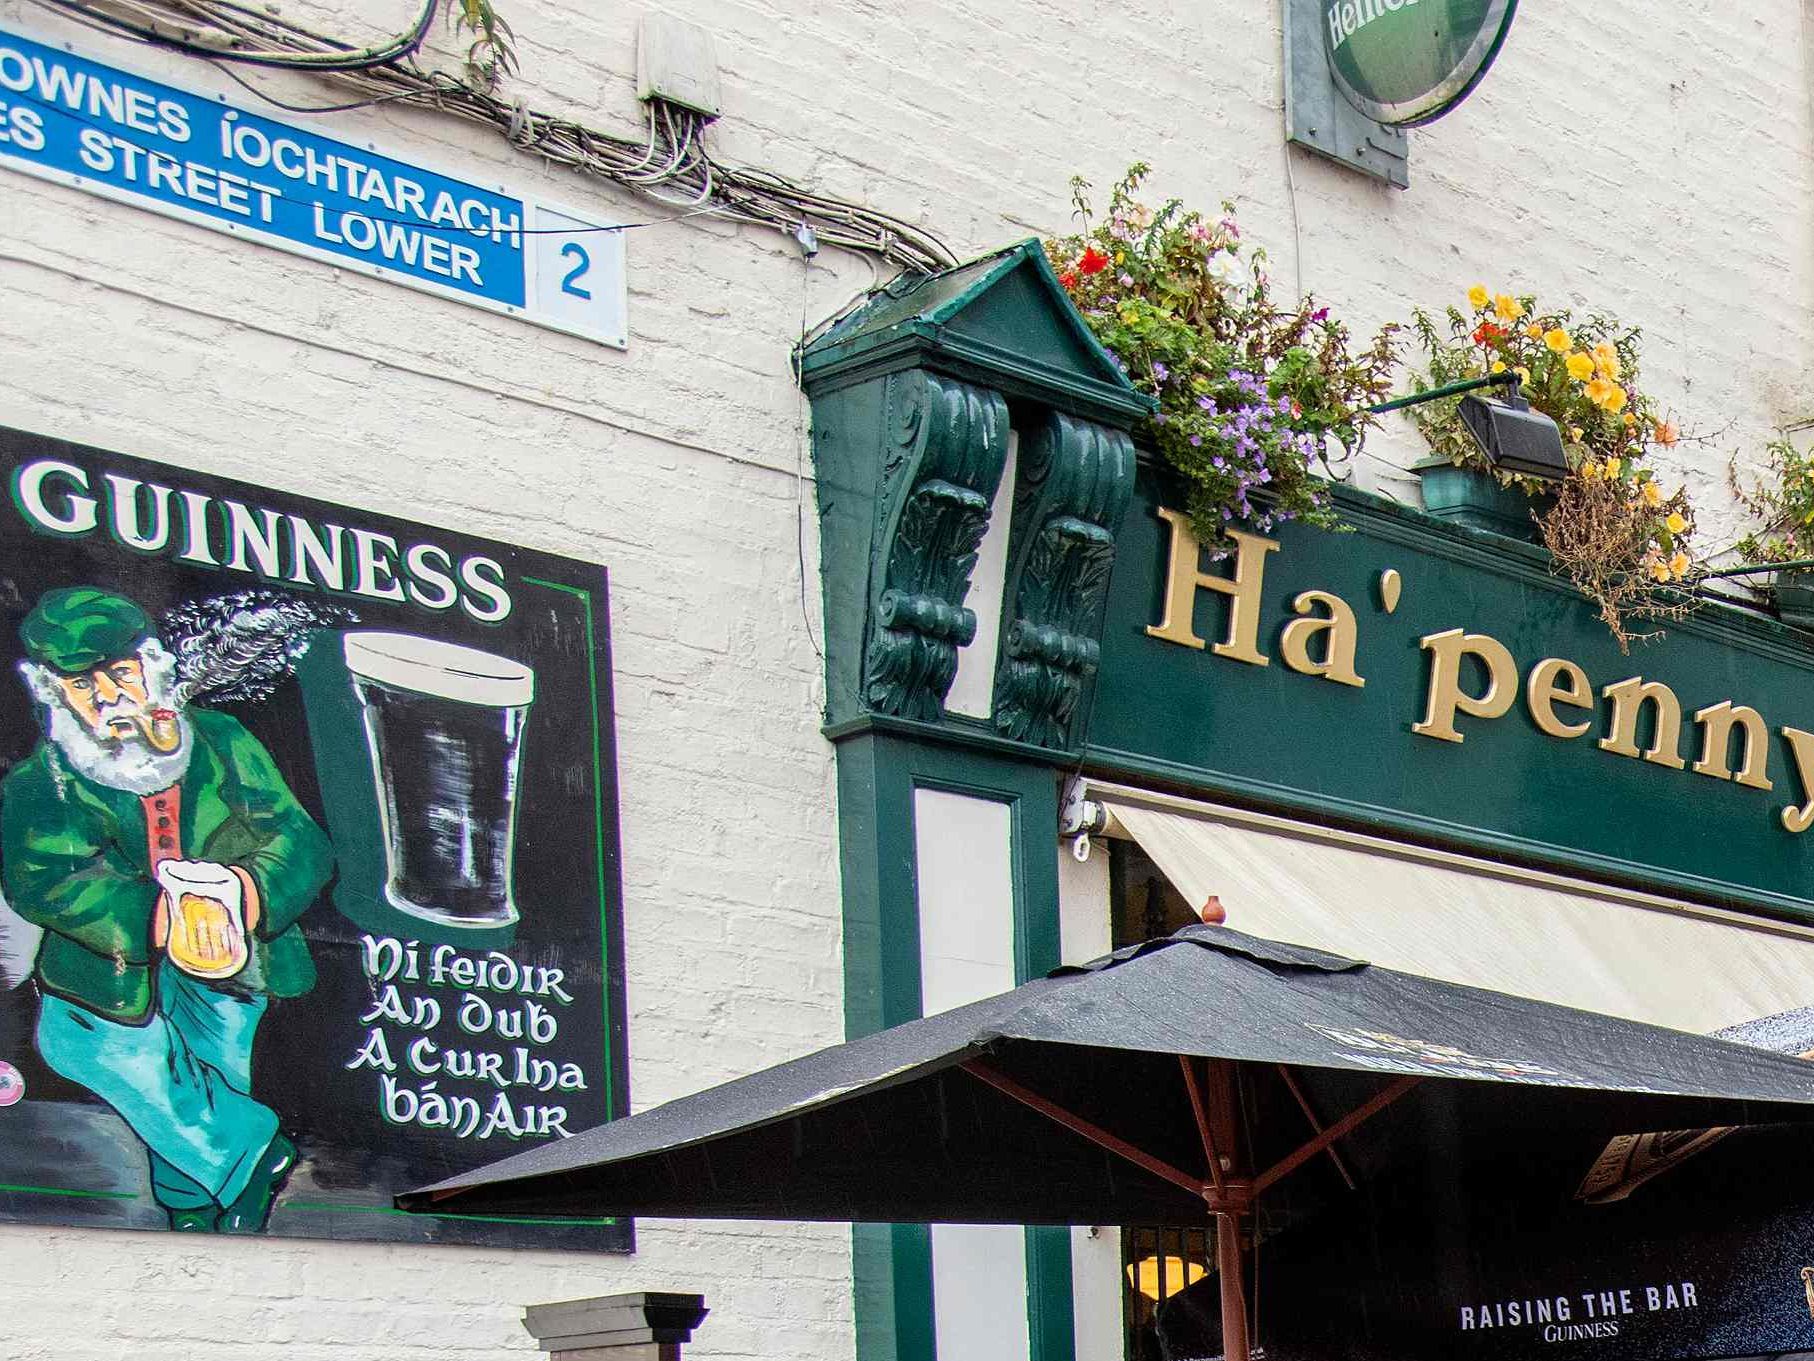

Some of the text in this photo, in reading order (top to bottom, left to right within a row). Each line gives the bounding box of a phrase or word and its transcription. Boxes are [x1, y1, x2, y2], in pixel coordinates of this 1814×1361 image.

[220, 110, 521, 250] ÍOCHTARACH
[80, 132, 283, 224] STREET
[313, 201, 485, 288] LOWER
[560, 242, 592, 300] 2
[18, 460, 513, 623] GUINNESS
[360, 985, 442, 1031] An
[347, 1027, 396, 1072] A
[1460, 1283, 1699, 1330] RAISING THE BAR
[1543, 1320, 1619, 1344] GUINNESS
